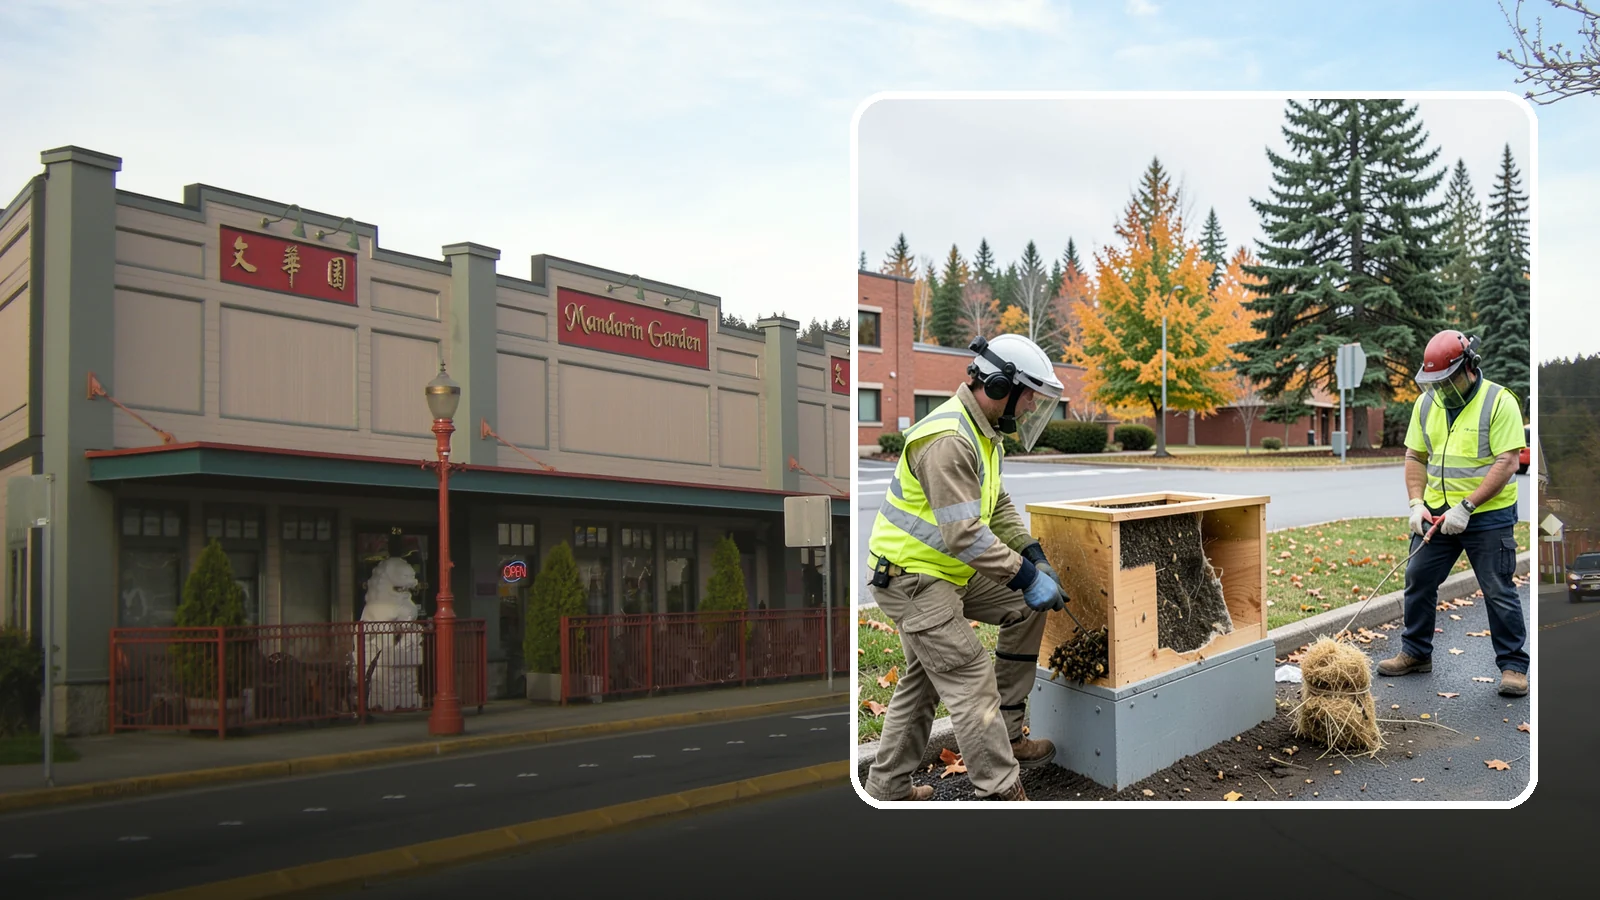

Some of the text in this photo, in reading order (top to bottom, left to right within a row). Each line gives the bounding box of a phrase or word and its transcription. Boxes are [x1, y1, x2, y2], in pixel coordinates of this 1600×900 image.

[231, 235, 346, 291] 文華園
[564, 302, 701, 352] Mandarin Garden
[503, 565, 527, 578] OPEN
